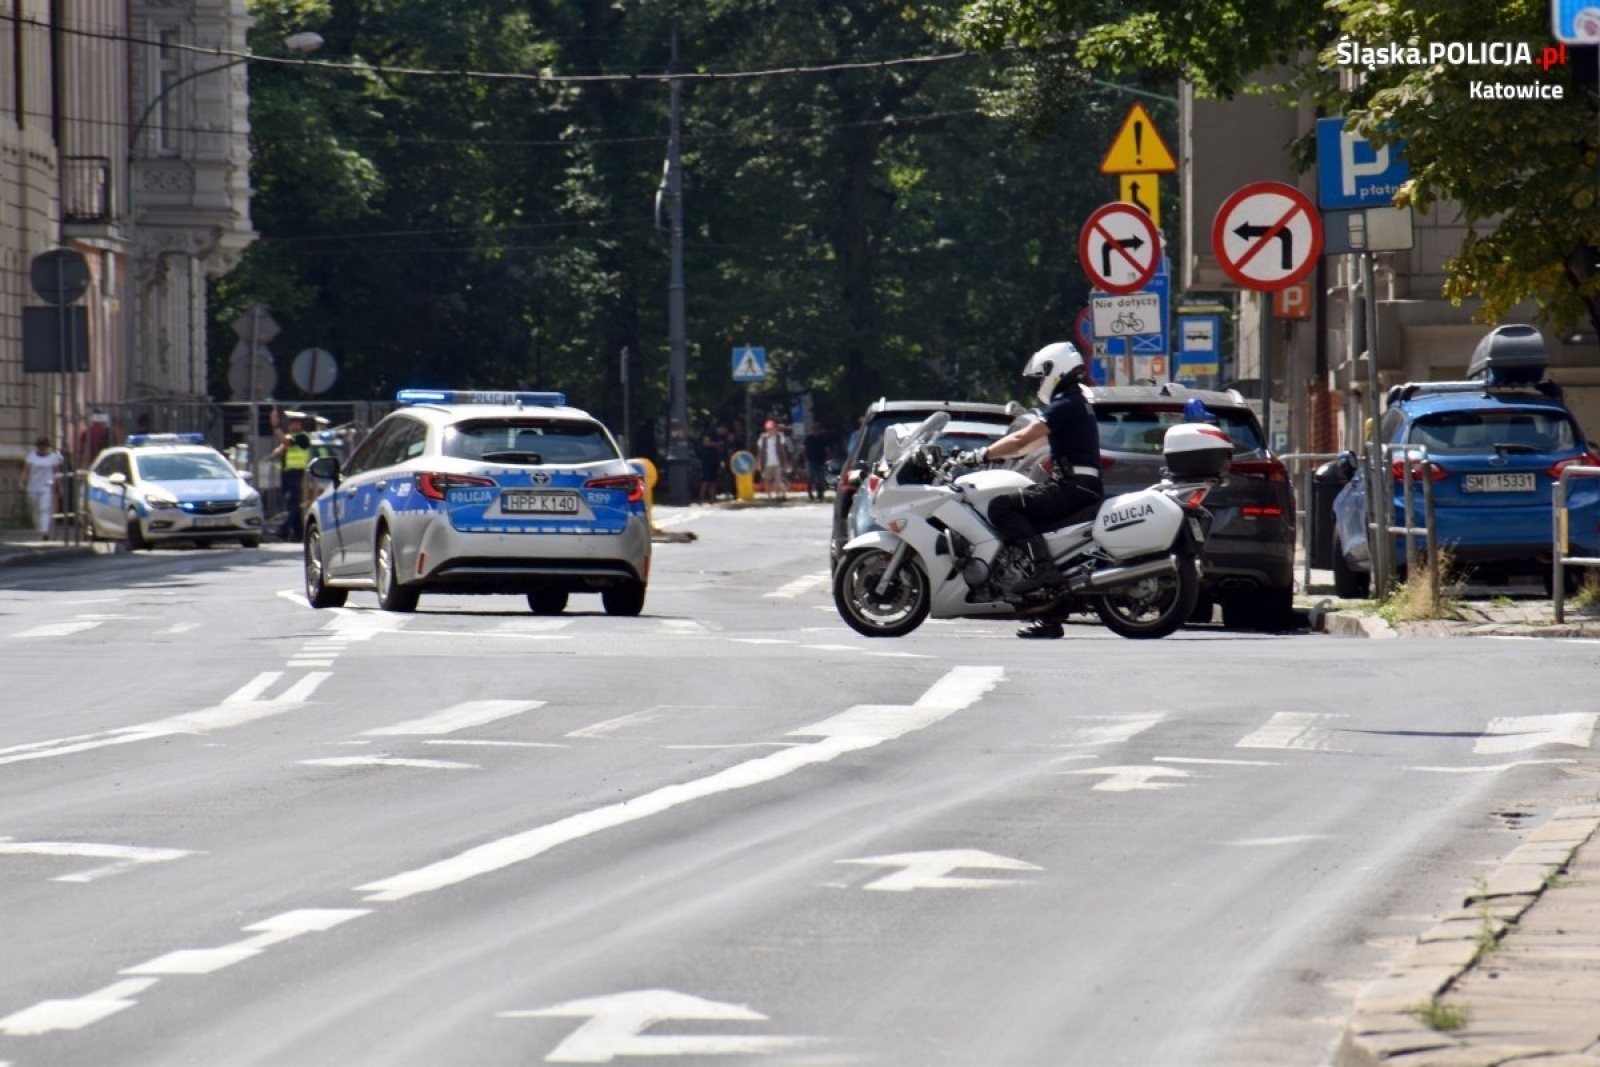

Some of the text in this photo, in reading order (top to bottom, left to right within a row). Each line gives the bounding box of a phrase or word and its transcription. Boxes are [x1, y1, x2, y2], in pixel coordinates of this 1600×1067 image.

[1340, 131, 1389, 196] P
[1360, 184, 1399, 200] płatn
[1095, 298, 1157, 309] Nie dotyczy
[1283, 286, 1304, 313] P
[470, 392, 517, 403] POLICJA
[1467, 474, 1533, 489] SMI 15331
[451, 491, 493, 502] POLICJA
[510, 495, 575, 511] HPP K140
[1102, 504, 1155, 526] POLICJA
